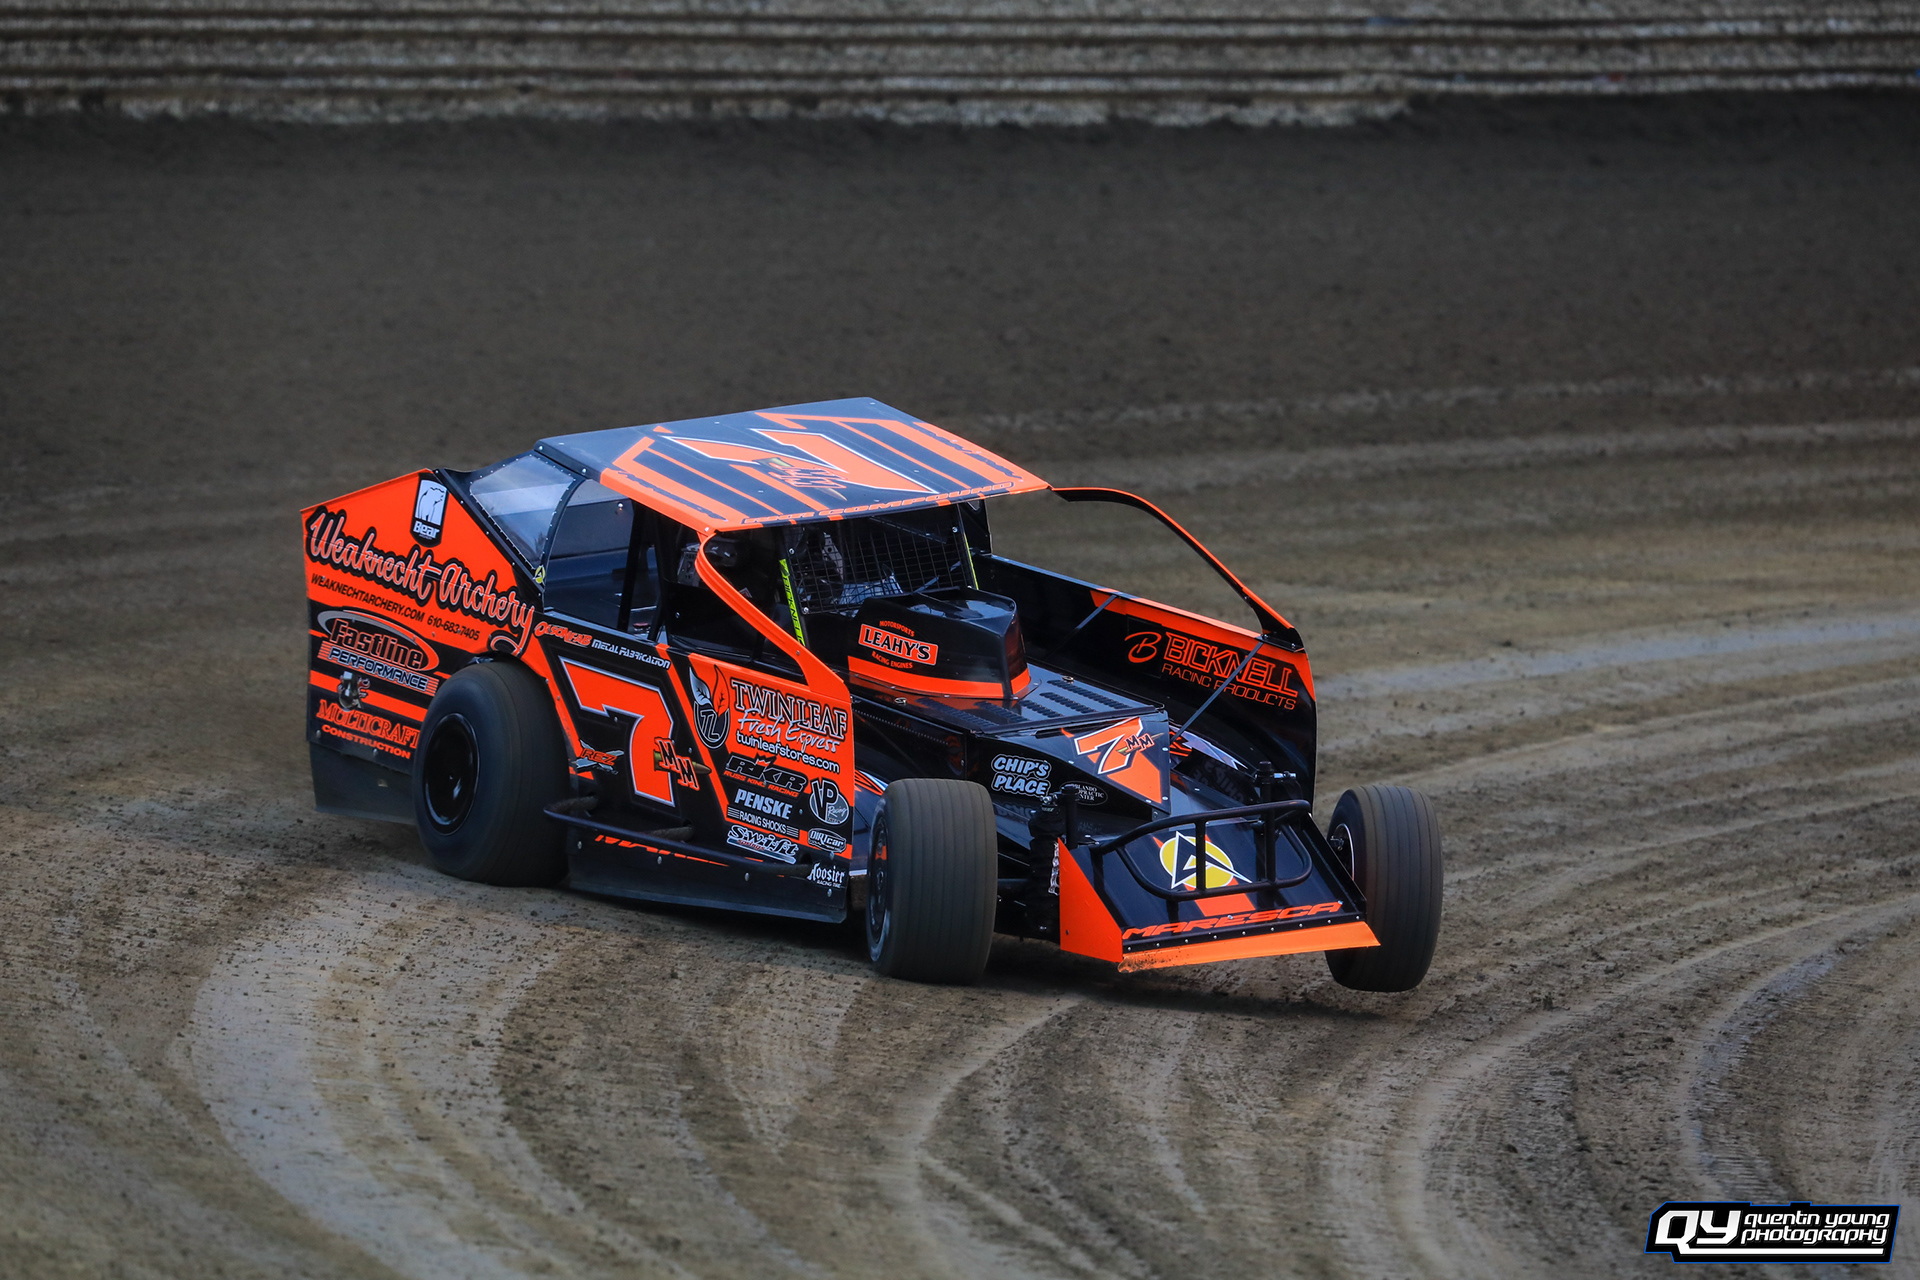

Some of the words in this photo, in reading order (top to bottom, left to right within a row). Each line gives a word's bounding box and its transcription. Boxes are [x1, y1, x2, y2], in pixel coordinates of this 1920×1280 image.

[818, 482, 1014, 514] COMPOUND
[413, 521, 440, 538] Bear
[309, 511, 441, 601] Weaknecht
[440, 562, 536, 662] Archery
[311, 572, 425, 622] WEAKNECHTARCHERY.COM
[329, 618, 424, 670] Fastline
[863, 628, 931, 660] LEAHY'S
[879, 620, 915, 637] MOTORSPORTS
[328, 645, 429, 692] PERFORMANCE
[871, 650, 890, 665] RACING
[890, 660, 913, 669] ENGINES
[1163, 631, 1299, 698] BICKNELL
[1162, 663, 1212, 688] RACING
[1213, 679, 1297, 710] PRODUCTS
[316, 699, 421, 749] MULTICRAFT
[731, 677, 847, 741] TWINLEAF
[322, 724, 411, 759] CONSTRUCTION
[558, 654, 676, 807] 7
[738, 708, 785, 742] Fresh
[785, 718, 841, 753] Express
[1074, 716, 1144, 774] 7
[1124, 733, 1155, 752] MM
[580, 748, 617, 766] REZ
[655, 737, 700, 791] MM
[736, 731, 840, 774] twinleafstores.com
[993, 756, 1050, 778] CHIP'S
[723, 770, 746, 782] RUSS
[747, 778, 766, 788] KING
[768, 784, 799, 798] RACING
[993, 776, 1049, 797] PLACE
[734, 789, 793, 820] PENSKE
[827, 804, 848, 818] Racing
[739, 810, 762, 827] RACING
[762, 816, 787, 835] SHOCKS
[810, 829, 844, 848] DIRTcar
[728, 825, 799, 857] Swift
[807, 862, 845, 882] Hoosier
[1122, 900, 1343, 940] MARESCA
